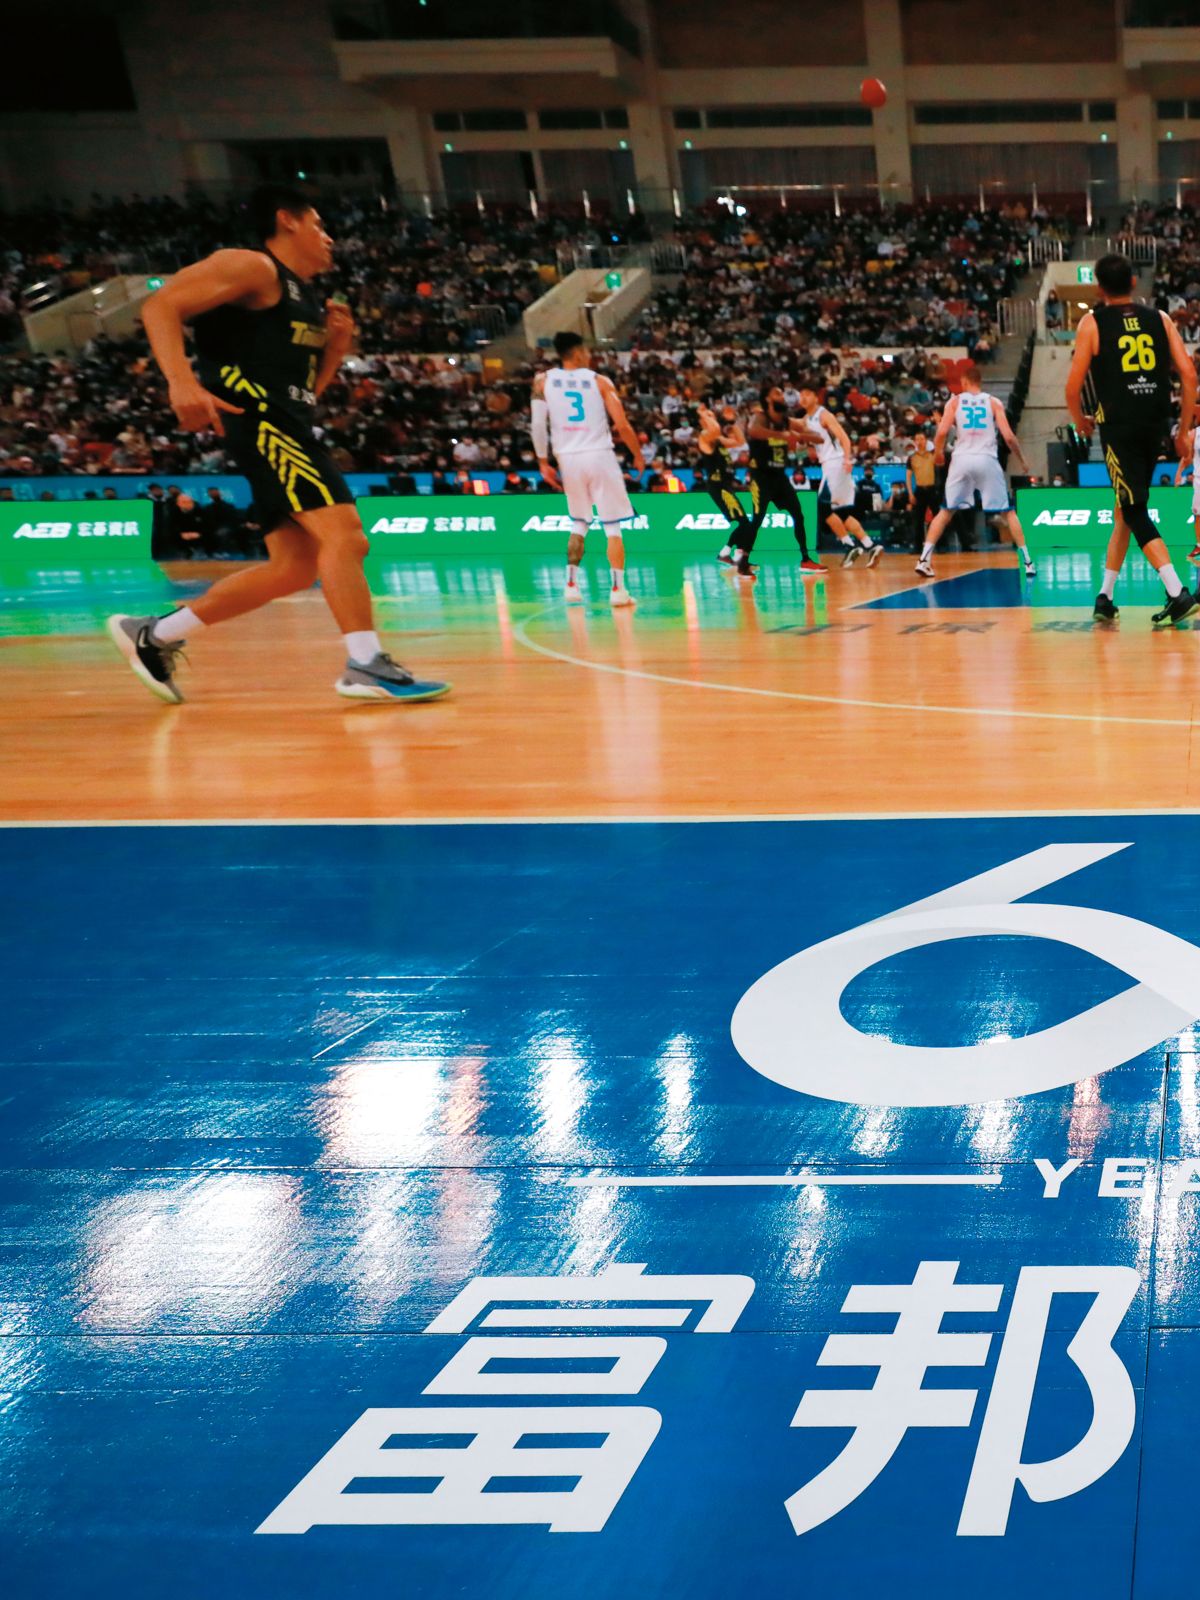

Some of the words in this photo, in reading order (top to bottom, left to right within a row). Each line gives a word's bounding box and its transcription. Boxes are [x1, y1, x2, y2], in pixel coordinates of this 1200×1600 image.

[1123, 317, 1142, 332] LEE
[1118, 334, 1156, 372] 26
[564, 391, 586, 422] 3
[961, 406, 987, 429] 32
[370, 517, 429, 534] AEB
[1033, 509, 1091, 526] AEB
